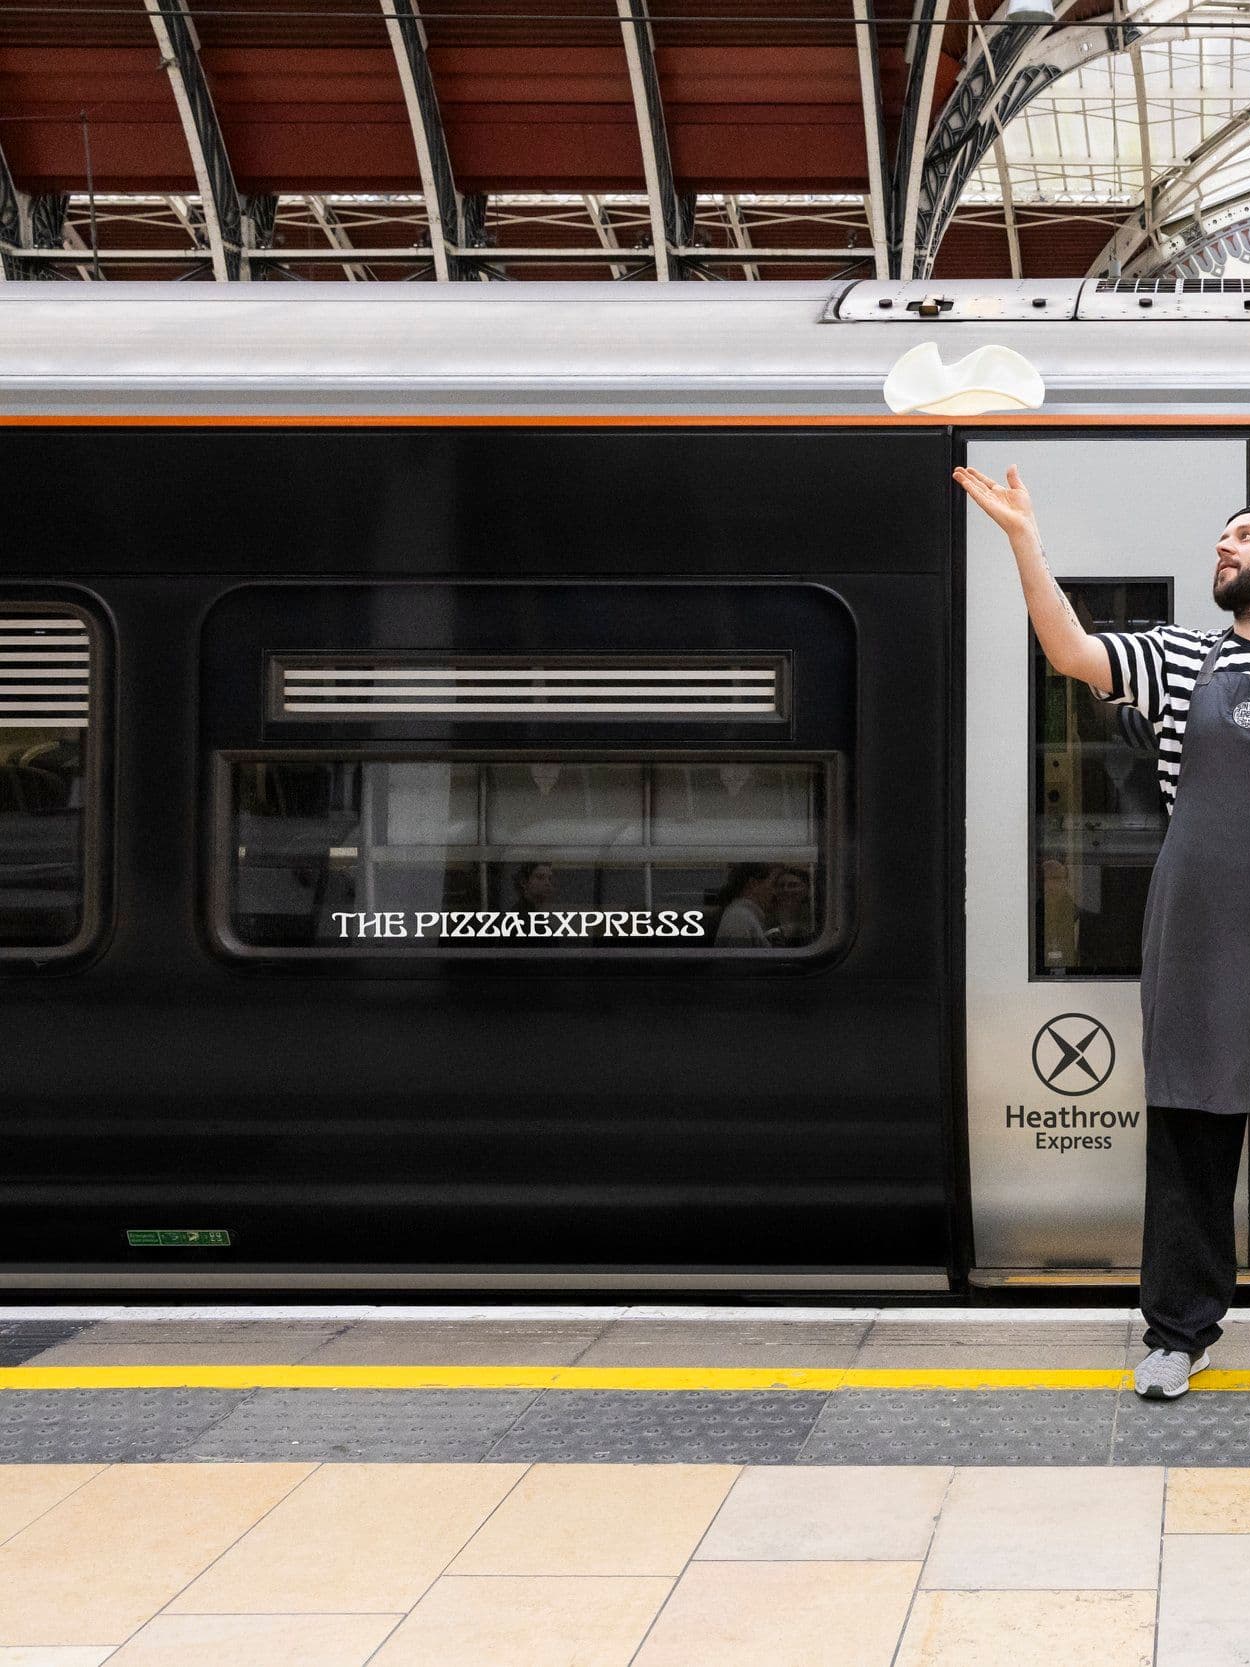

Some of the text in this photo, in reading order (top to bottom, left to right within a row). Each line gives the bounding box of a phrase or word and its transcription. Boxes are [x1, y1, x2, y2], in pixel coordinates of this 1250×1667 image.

[331, 910, 705, 938] THE PIZZAEXPRESS
[1005, 1105, 1141, 1129] Heathrow
[1035, 1131, 1113, 1154] Express
